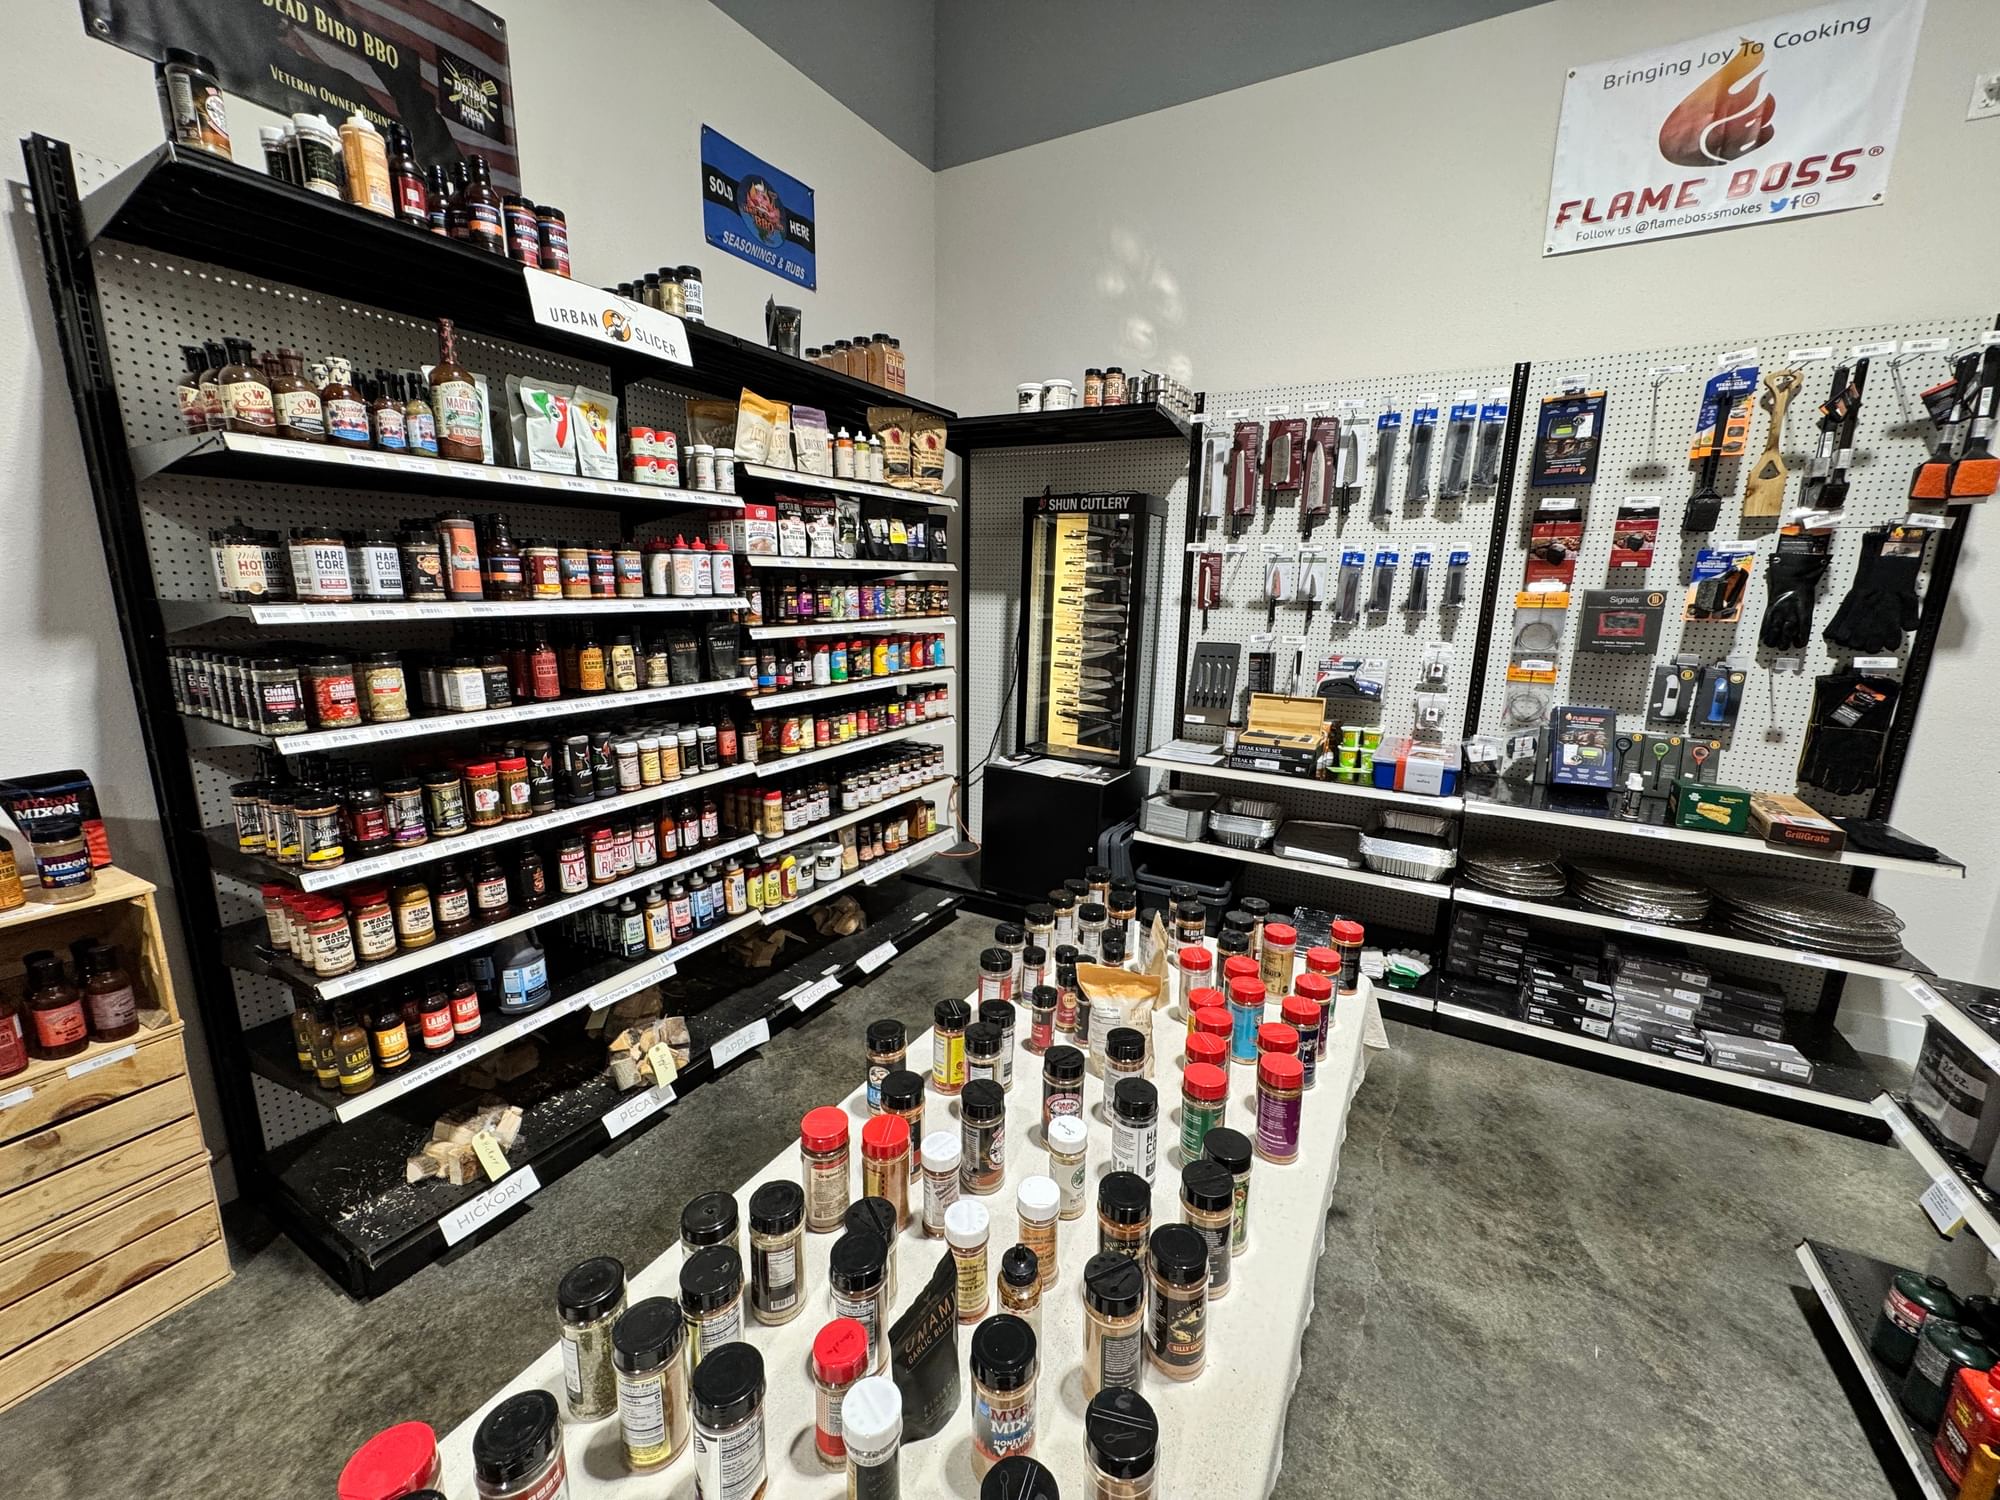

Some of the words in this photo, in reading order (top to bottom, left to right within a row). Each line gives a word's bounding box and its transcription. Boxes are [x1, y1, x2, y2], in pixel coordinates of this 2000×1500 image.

[314, 6, 357, 48] BIRD
[1603, 57, 1692, 90] Bringing
[1697, 48, 1734, 71] Joy
[1740, 38, 1765, 57] To
[1774, 15, 1872, 50] Cooking
[269, 63, 318, 98] VETERAN
[320, 86, 357, 114] OWNED
[709, 175, 734, 202] SOLD
[1554, 177, 1707, 230] FLAME
[1575, 226, 1615, 242] Follow
[1618, 224, 1632, 236] us
[1635, 201, 1763, 233] @flamebosssmokes
[789, 219, 811, 242] HERE
[722, 230, 777, 266] SEASONINGS
[777, 257, 784, 270] &
[786, 260, 806, 281] RUBS
[549, 306, 599, 328] URBAN
[635, 327, 678, 359] SLICER
[253, 389, 265, 400] W
[306, 398, 317, 408] W
[1048, 497, 1078, 511] SHUN
[1080, 496, 1130, 510] CUTLERY
[315, 549, 344, 560] HARD
[316, 560, 345, 570] CORE
[1609, 595, 1640, 605] Signals
[263, 687, 295, 696] CHIMI
[12, 794, 77, 810] MYRON
[14, 802, 80, 820] MIXON
[1785, 830, 1831, 844] GrillGrate
[614, 846, 632, 858] HOT
[44, 856, 88, 872] MIXON
[55, 871, 86, 882] CHICKEN
[316, 928, 349, 944] SWAMP
[324, 934, 346, 946] BOYS
[801, 981, 833, 1005] CHERRY
[723, 1030, 757, 1057] APPLE
[402, 1070, 430, 1088] Lane's
[429, 1059, 453, 1075] Sauce
[456, 1047, 478, 1061] $9.99
[619, 1091, 662, 1124] PECAN
[455, 1176, 525, 1231] HICKORY
[908, 1334, 934, 1365] GARLIC
[721, 1427, 747, 1444] Nutrition
[721, 1444, 750, 1461] Calories
